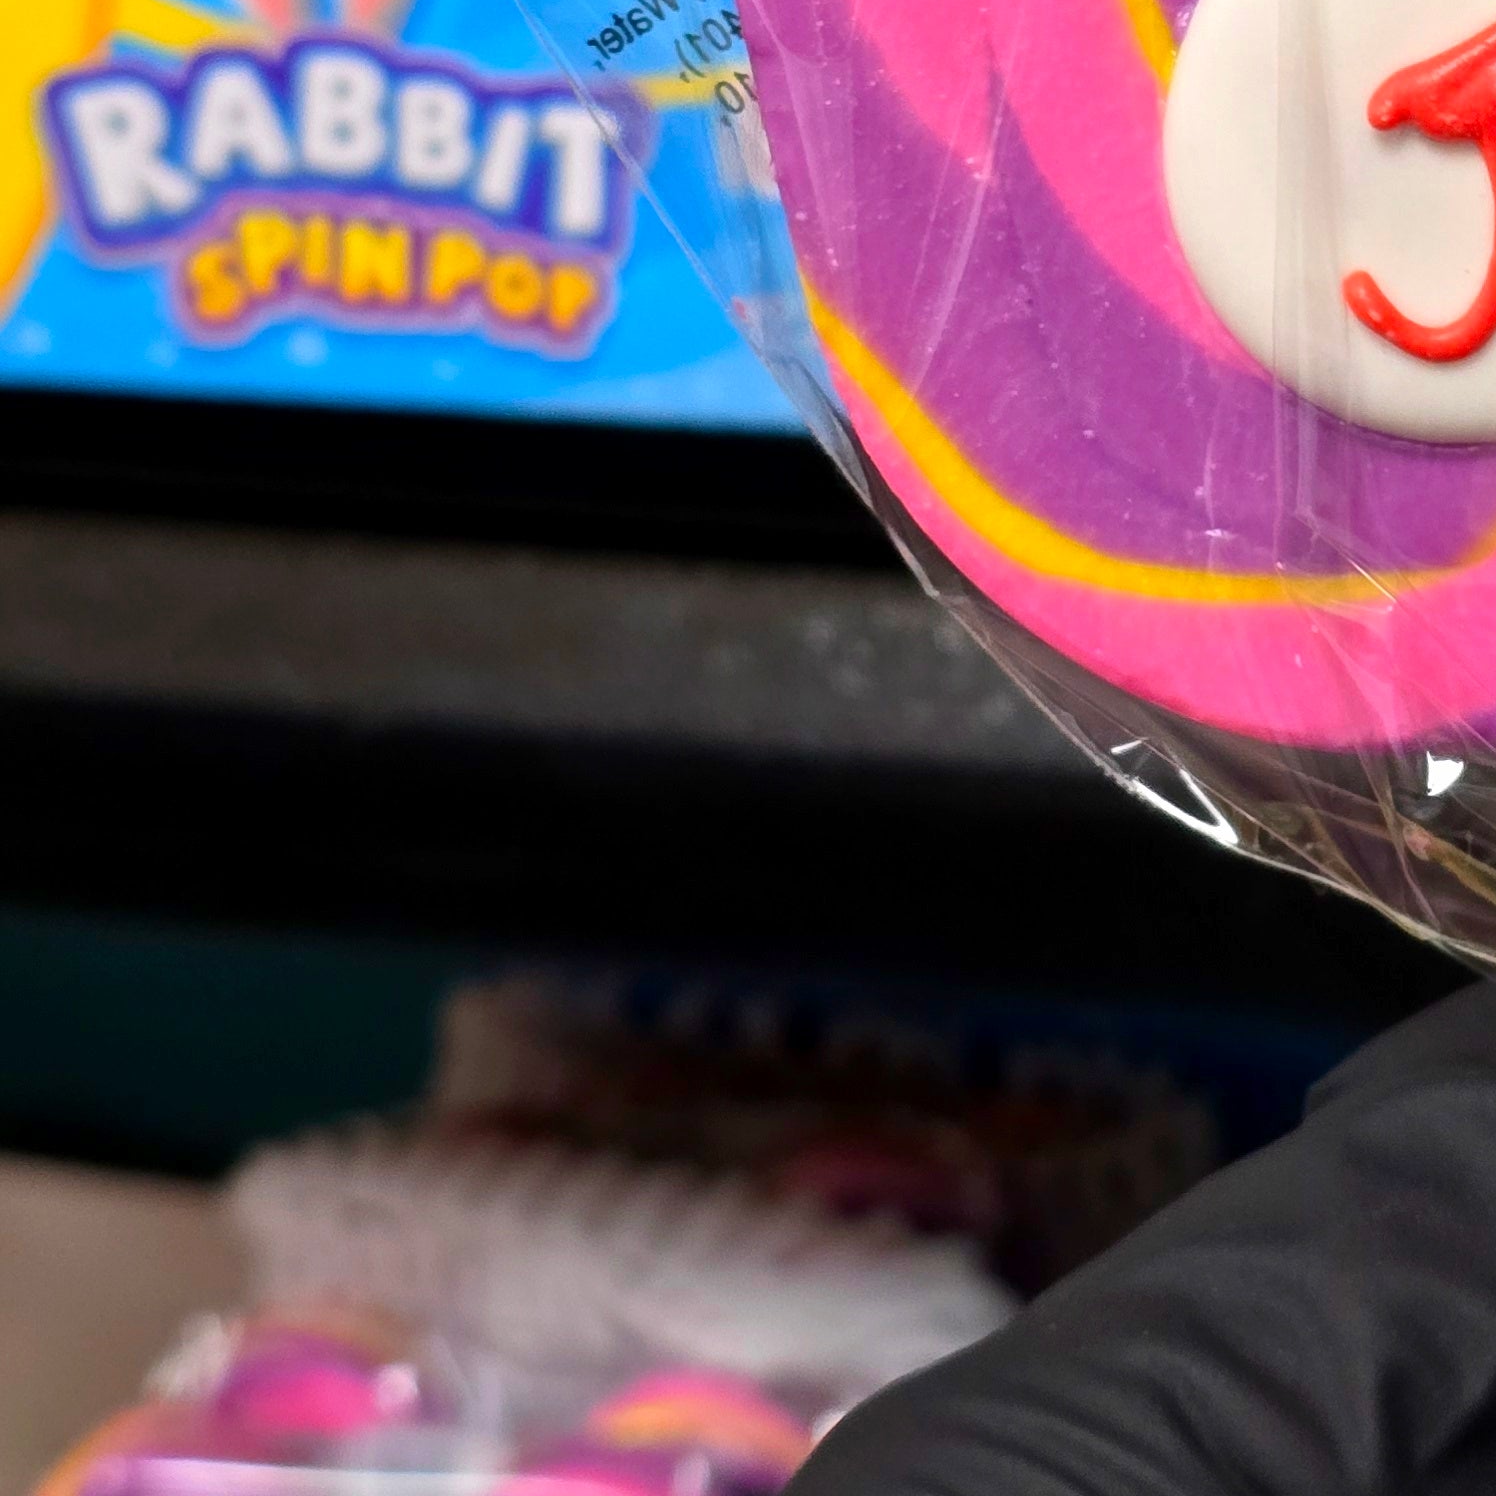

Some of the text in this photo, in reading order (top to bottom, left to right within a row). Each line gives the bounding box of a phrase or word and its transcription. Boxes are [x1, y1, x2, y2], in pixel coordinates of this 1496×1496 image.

[70, 52, 618, 239] RABBIT
[185, 212, 598, 334] SPIN POP
